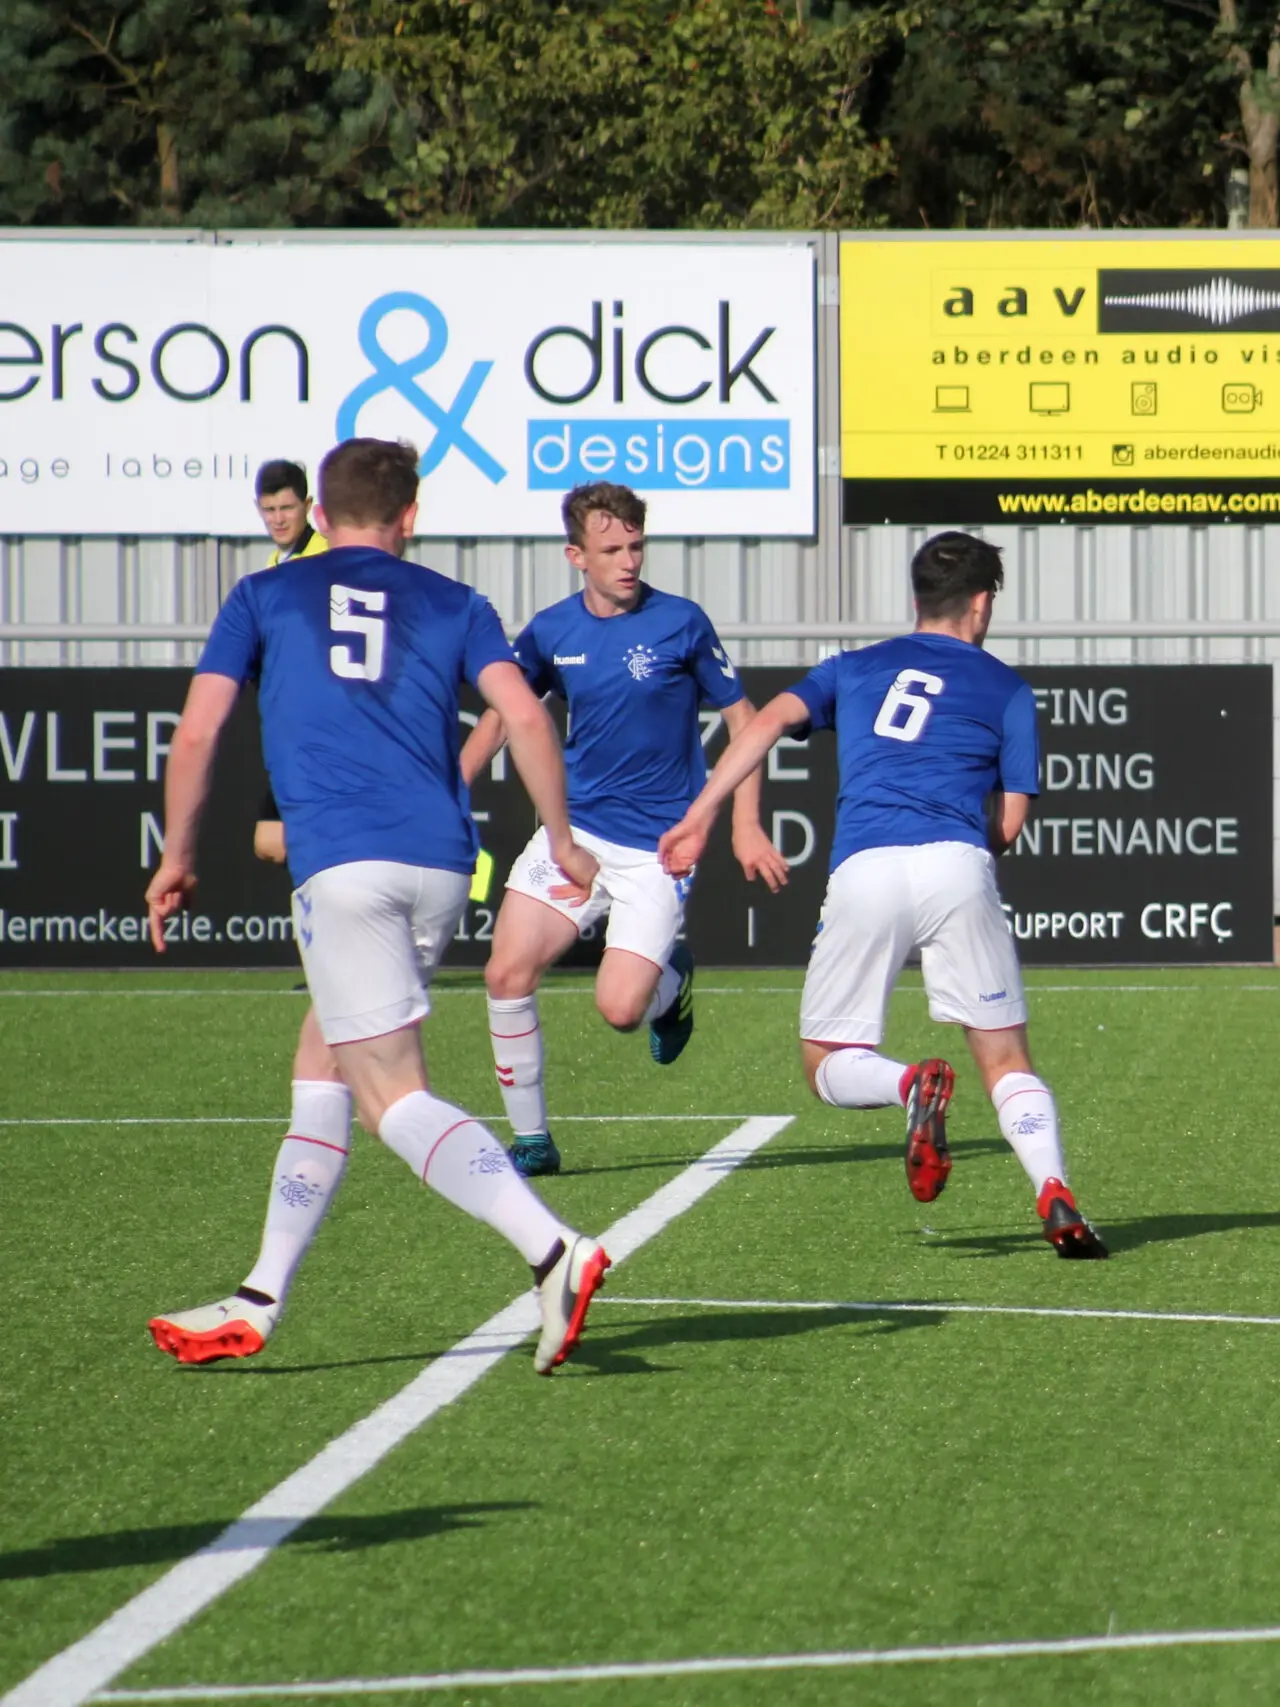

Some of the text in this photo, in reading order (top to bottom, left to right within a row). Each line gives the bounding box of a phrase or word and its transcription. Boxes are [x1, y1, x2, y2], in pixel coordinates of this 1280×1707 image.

[931, 345, 1099, 366] aberdeen
[1122, 345, 1219, 366] audio
[335, 291, 507, 485] &
[524, 300, 779, 404] dick
[105, 453, 307, 479] labelli
[532, 423, 786, 483] designs
[936, 444, 948, 460] T
[953, 444, 1010, 461] 01224
[1015, 444, 1083, 460] 311311
[329, 584, 386, 682] 5
[873, 669, 943, 742] 6
[1038, 752, 1155, 791] DING
[1002, 817, 1239, 856] NTENANCE
[1140, 902, 1234, 939] CRFC
